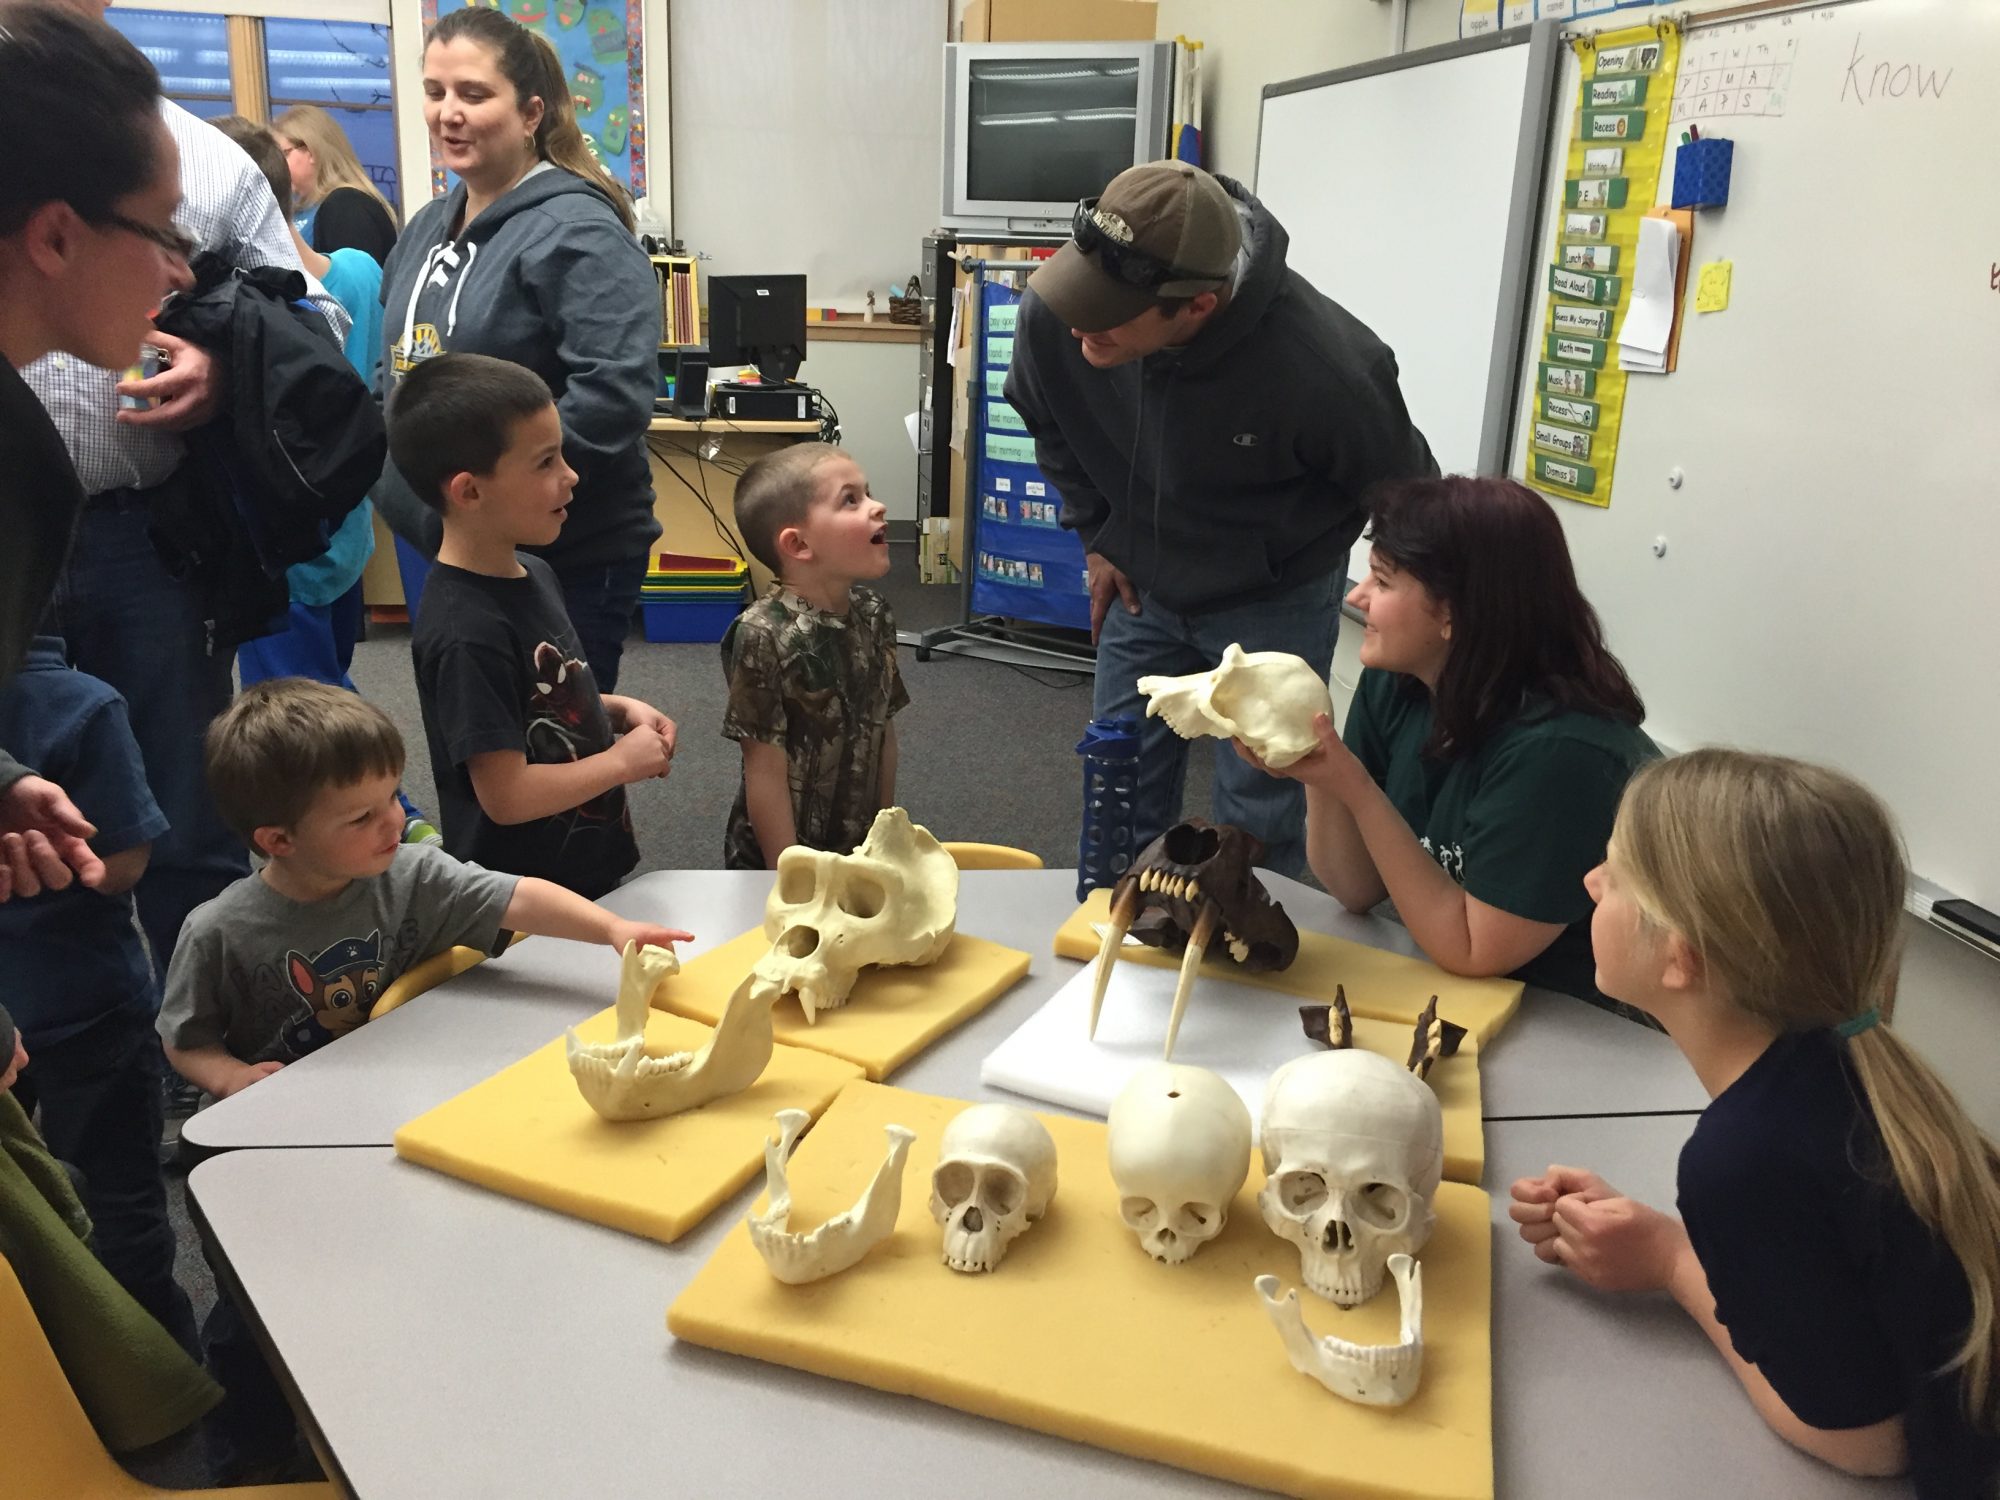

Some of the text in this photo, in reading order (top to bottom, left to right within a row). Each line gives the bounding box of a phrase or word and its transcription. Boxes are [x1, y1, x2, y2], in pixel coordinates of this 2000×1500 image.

[1470, 16, 1489, 33] apple
[1598, 55, 1624, 69] Opening
[1748, 70, 1757, 85] A
[1592, 87, 1618, 102] Reading
[1699, 98, 1708, 112] A
[1742, 93, 1751, 108] S
[1594, 121, 1615, 132] Recess
[1565, 252, 1582, 264] Lunch
[1554, 275, 1586, 293] Read Aloud
[1559, 342, 1574, 354] Math
[1548, 374, 1563, 386] Music
[1548, 401, 1568, 416] Recess
[1536, 430, 1572, 451] Small Groups
[1546, 465, 1568, 480] Dismiss
